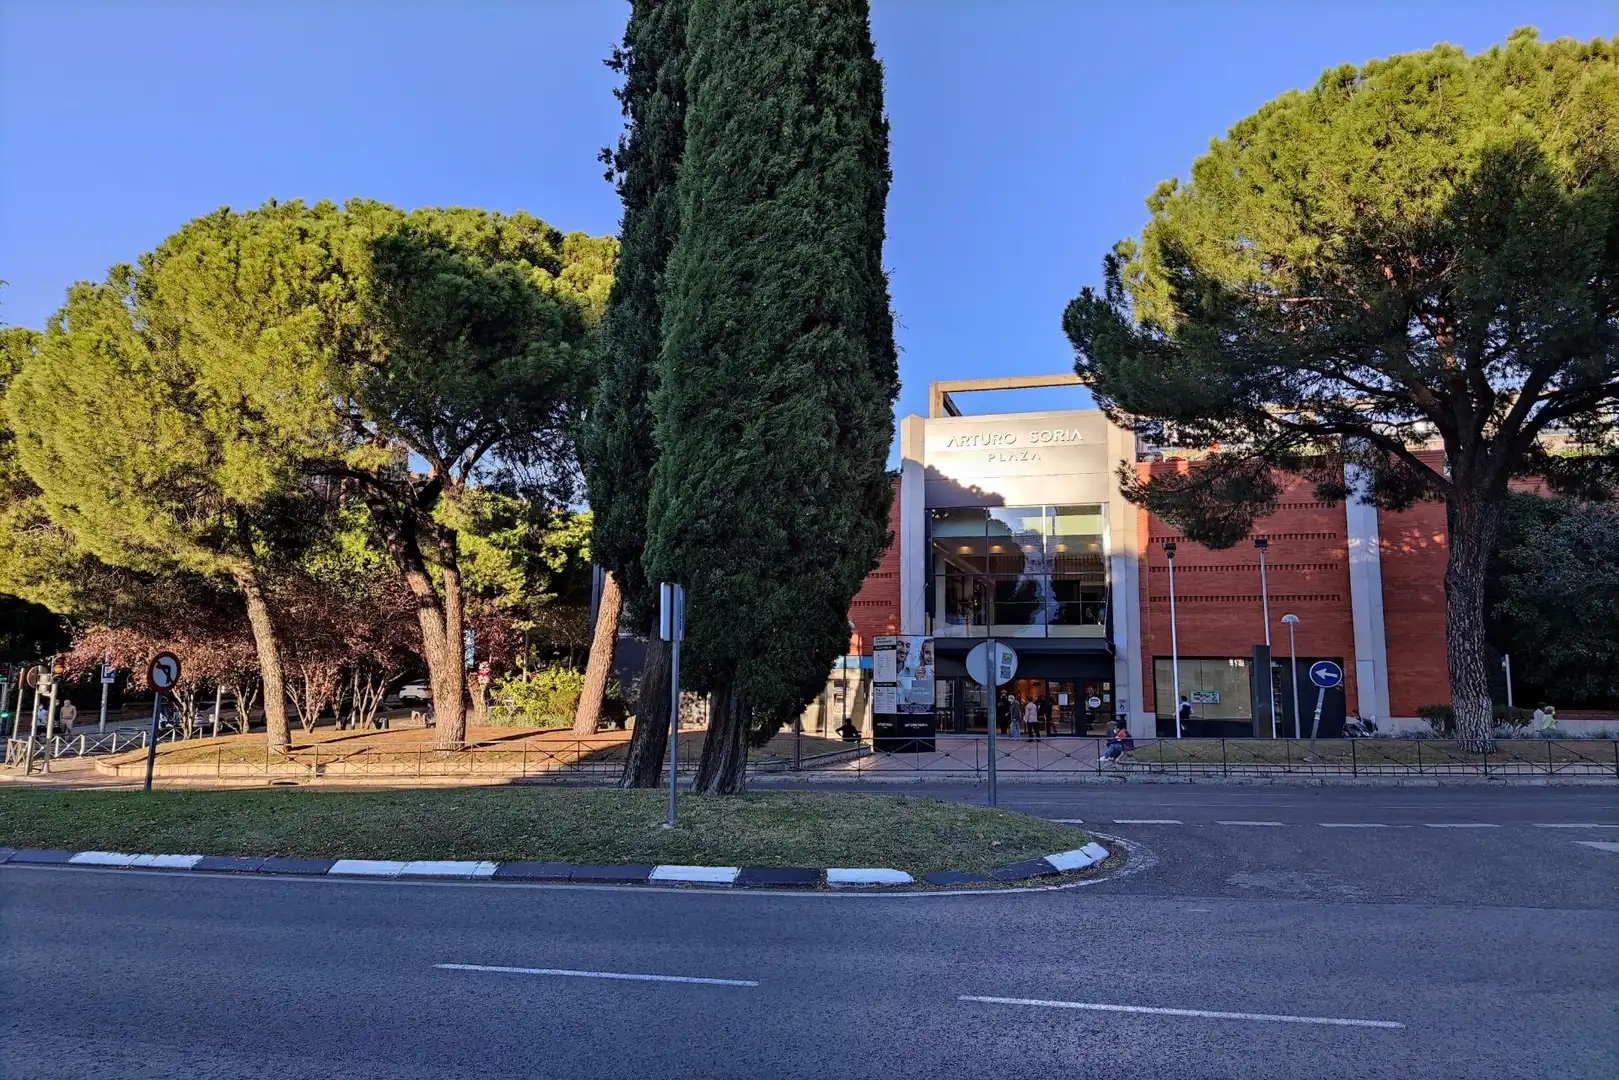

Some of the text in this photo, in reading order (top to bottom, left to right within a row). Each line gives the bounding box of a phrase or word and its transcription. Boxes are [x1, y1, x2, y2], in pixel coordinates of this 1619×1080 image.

[947, 428, 1083, 447] ARTURO SORIA
[988, 451, 1041, 462] PLAZA
